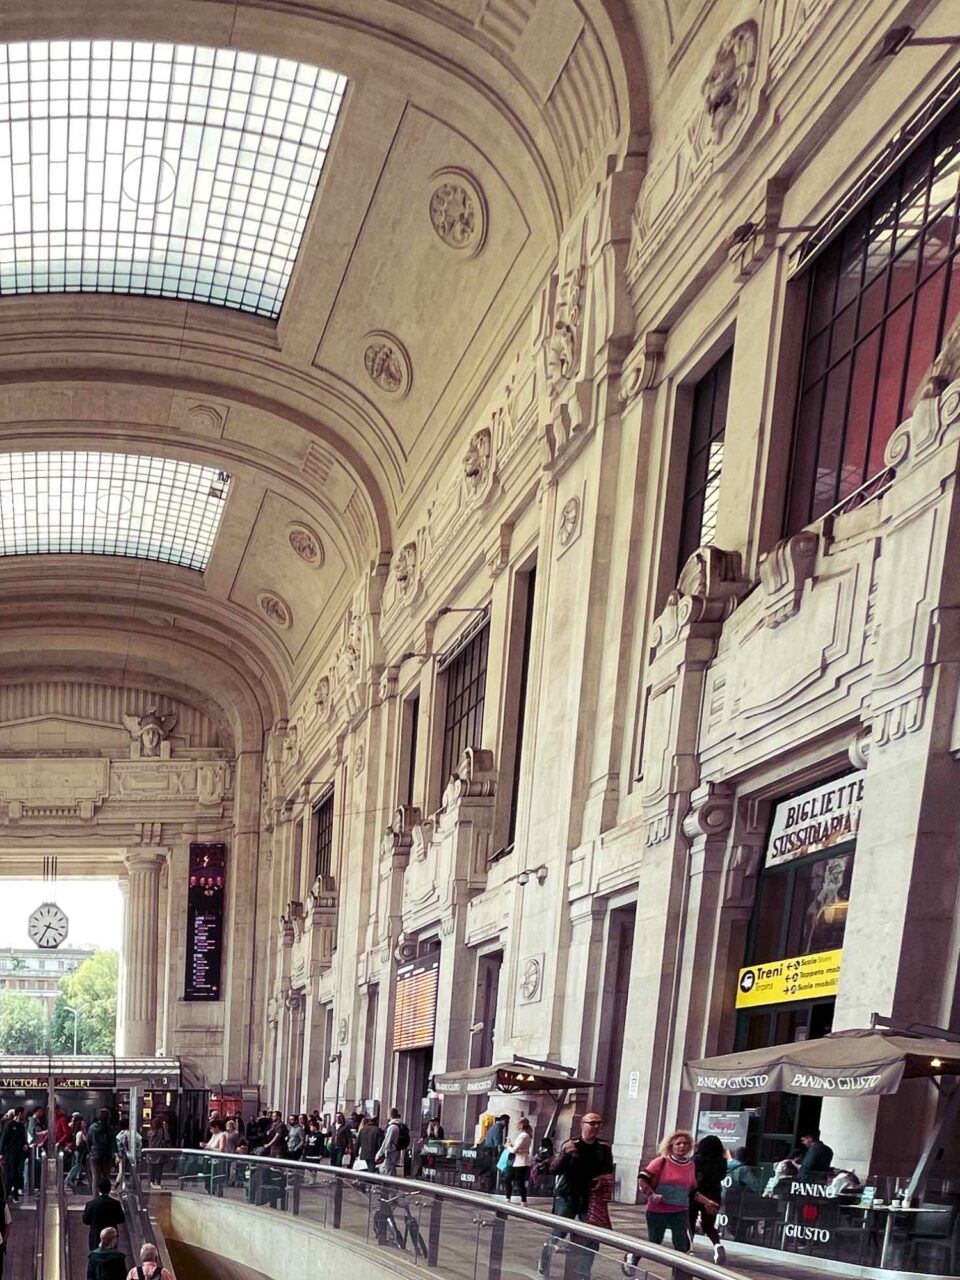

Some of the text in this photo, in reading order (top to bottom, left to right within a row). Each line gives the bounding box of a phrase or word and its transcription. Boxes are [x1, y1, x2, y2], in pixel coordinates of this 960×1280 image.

[771, 811, 852, 859] SUSSIDIARIA
[756, 963, 783, 980] Treni
[727, 1074, 769, 1089] GIUSTO
[791, 1074, 881, 1090] PANINO GIUSTO
[790, 1181, 836, 1199] PANINO
[785, 1223, 830, 1243] GIUSTO
